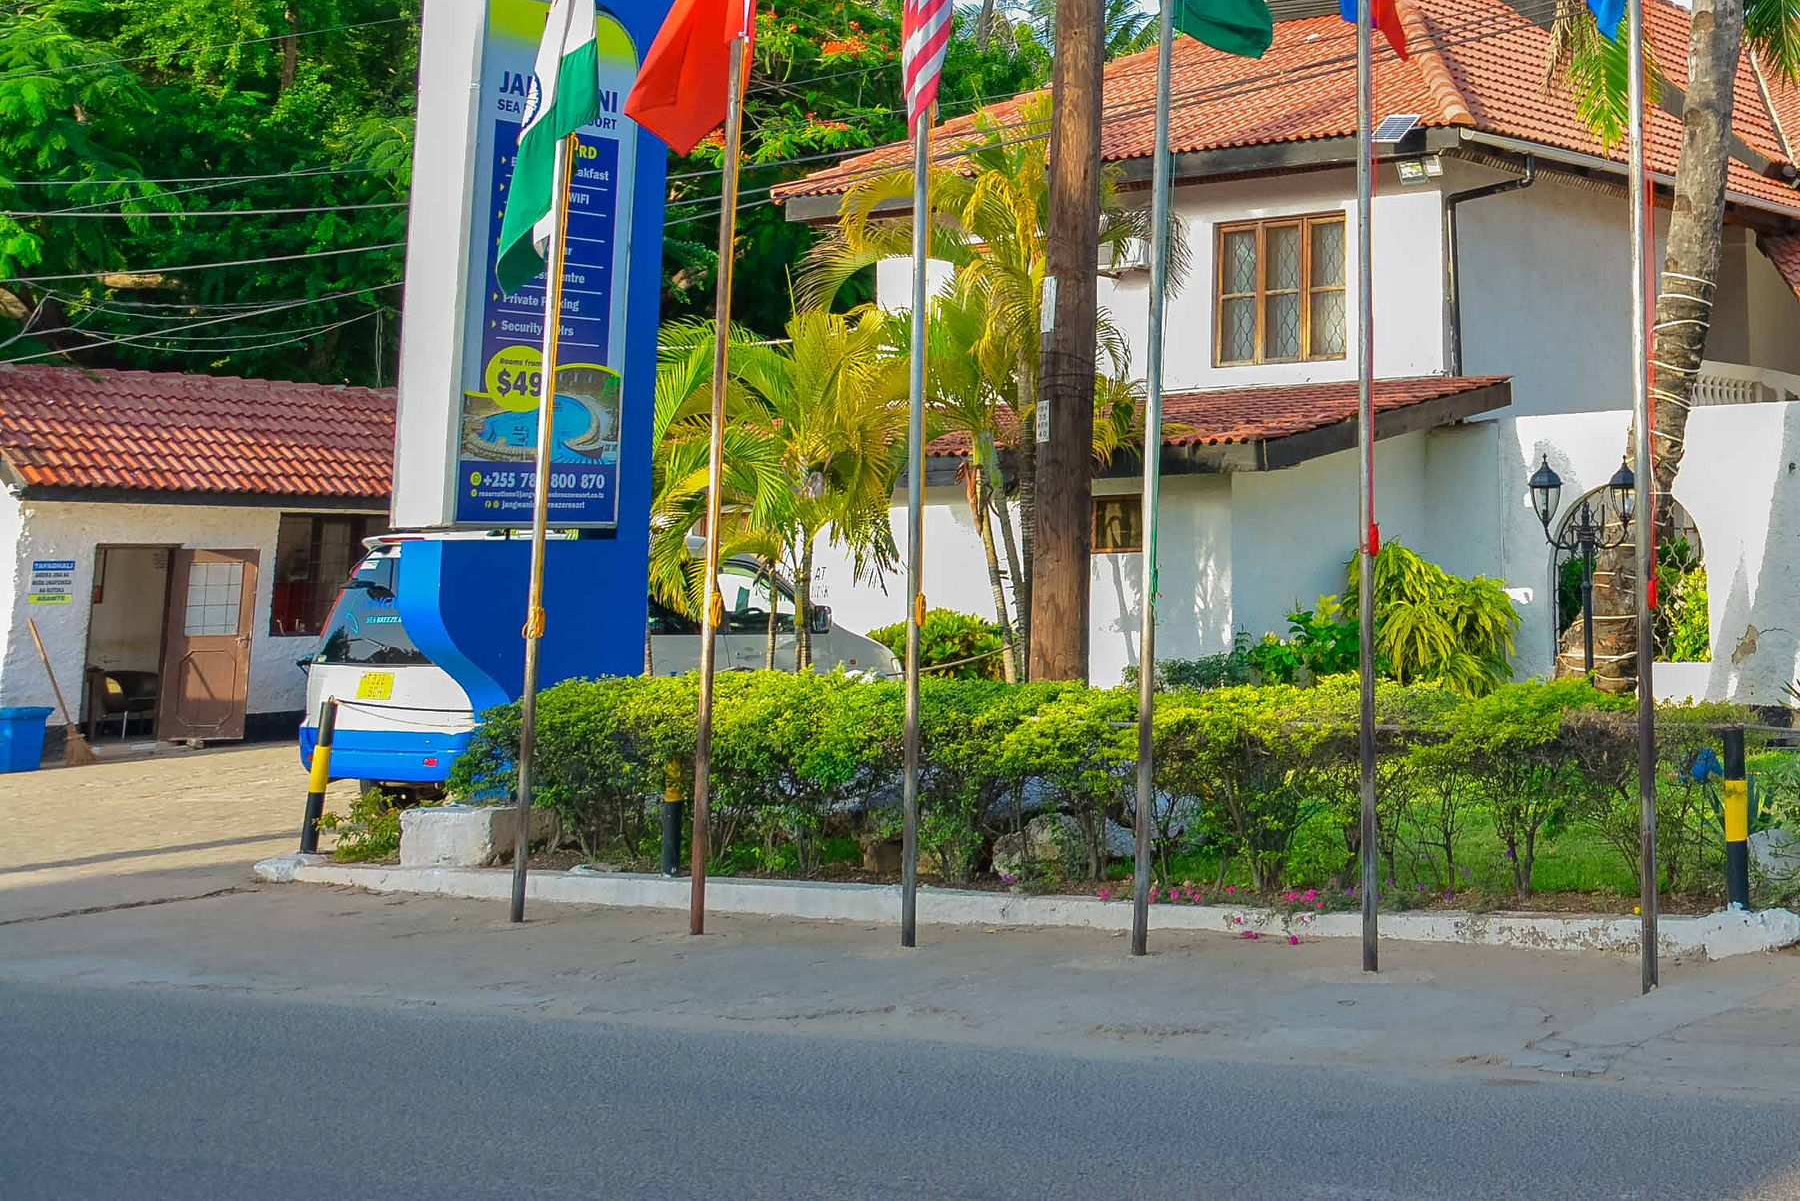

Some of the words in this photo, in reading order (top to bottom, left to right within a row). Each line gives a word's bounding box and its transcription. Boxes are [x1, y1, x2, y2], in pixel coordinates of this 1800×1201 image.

[497, 98, 520, 114] SEA
[501, 319, 543, 336] Security
[497, 368, 542, 397] $49
[483, 471, 516, 488] +255
[550, 473, 577, 489] 800
[580, 474, 606, 490] 870
